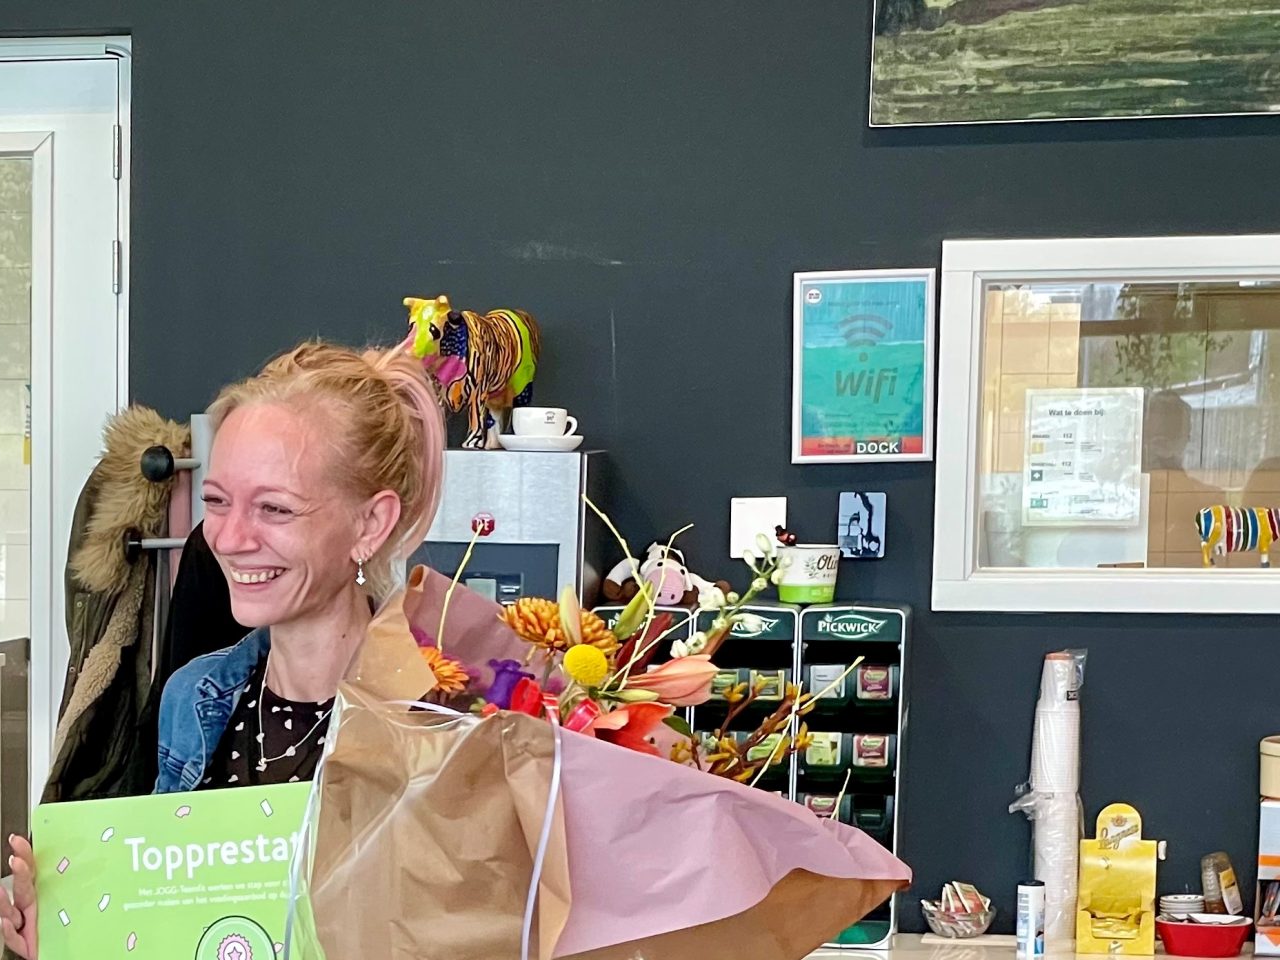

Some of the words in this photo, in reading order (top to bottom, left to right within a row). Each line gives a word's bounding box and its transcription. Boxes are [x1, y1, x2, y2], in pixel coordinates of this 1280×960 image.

[835, 367, 899, 404] Wifi
[1048, 408, 1064, 417] Wat
[1064, 409, 1072, 417] te
[1073, 408, 1093, 416] doen
[856, 441, 900, 454] DOCK
[817, 619, 880, 634] PICKWICK
